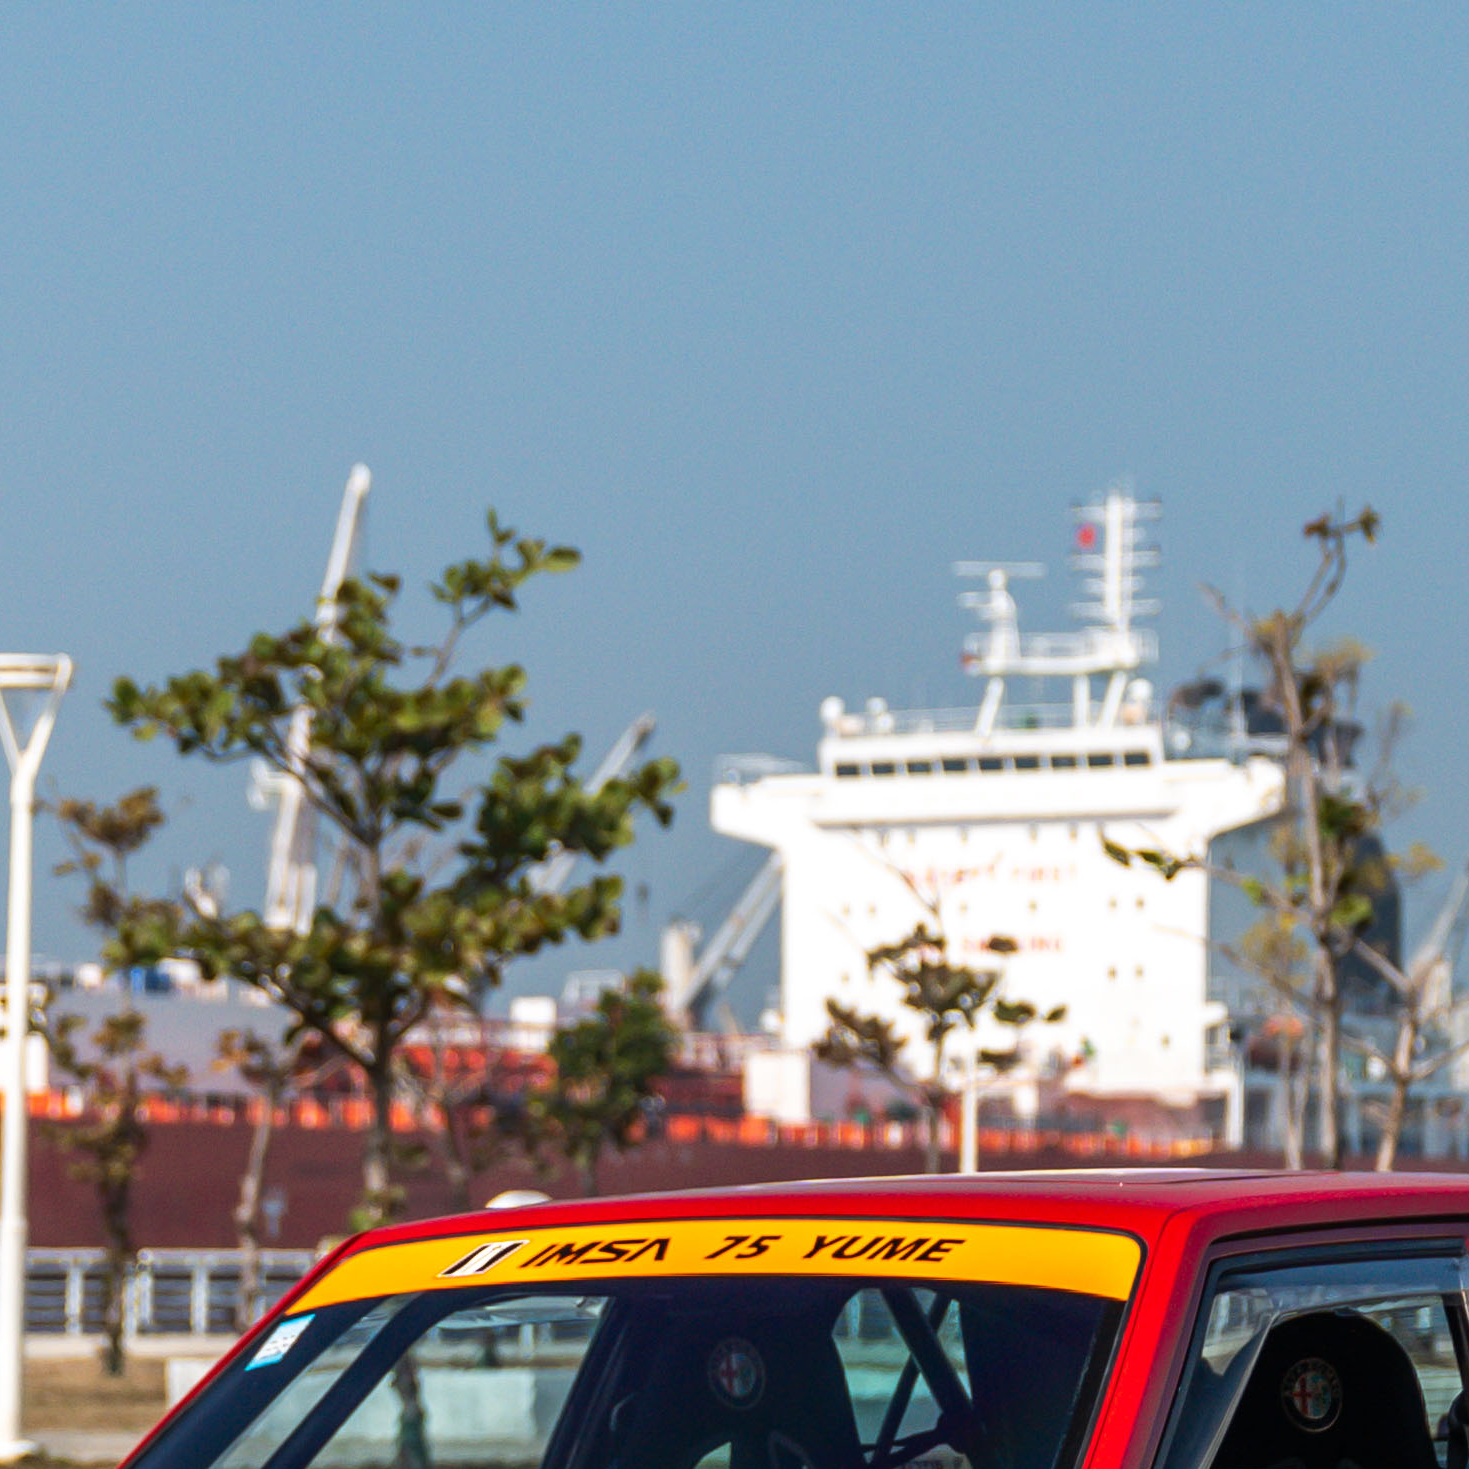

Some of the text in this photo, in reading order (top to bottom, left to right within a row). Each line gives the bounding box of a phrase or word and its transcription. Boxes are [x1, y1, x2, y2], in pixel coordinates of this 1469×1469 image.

[520, 1234, 967, 1270] IMSA 75 YUME
